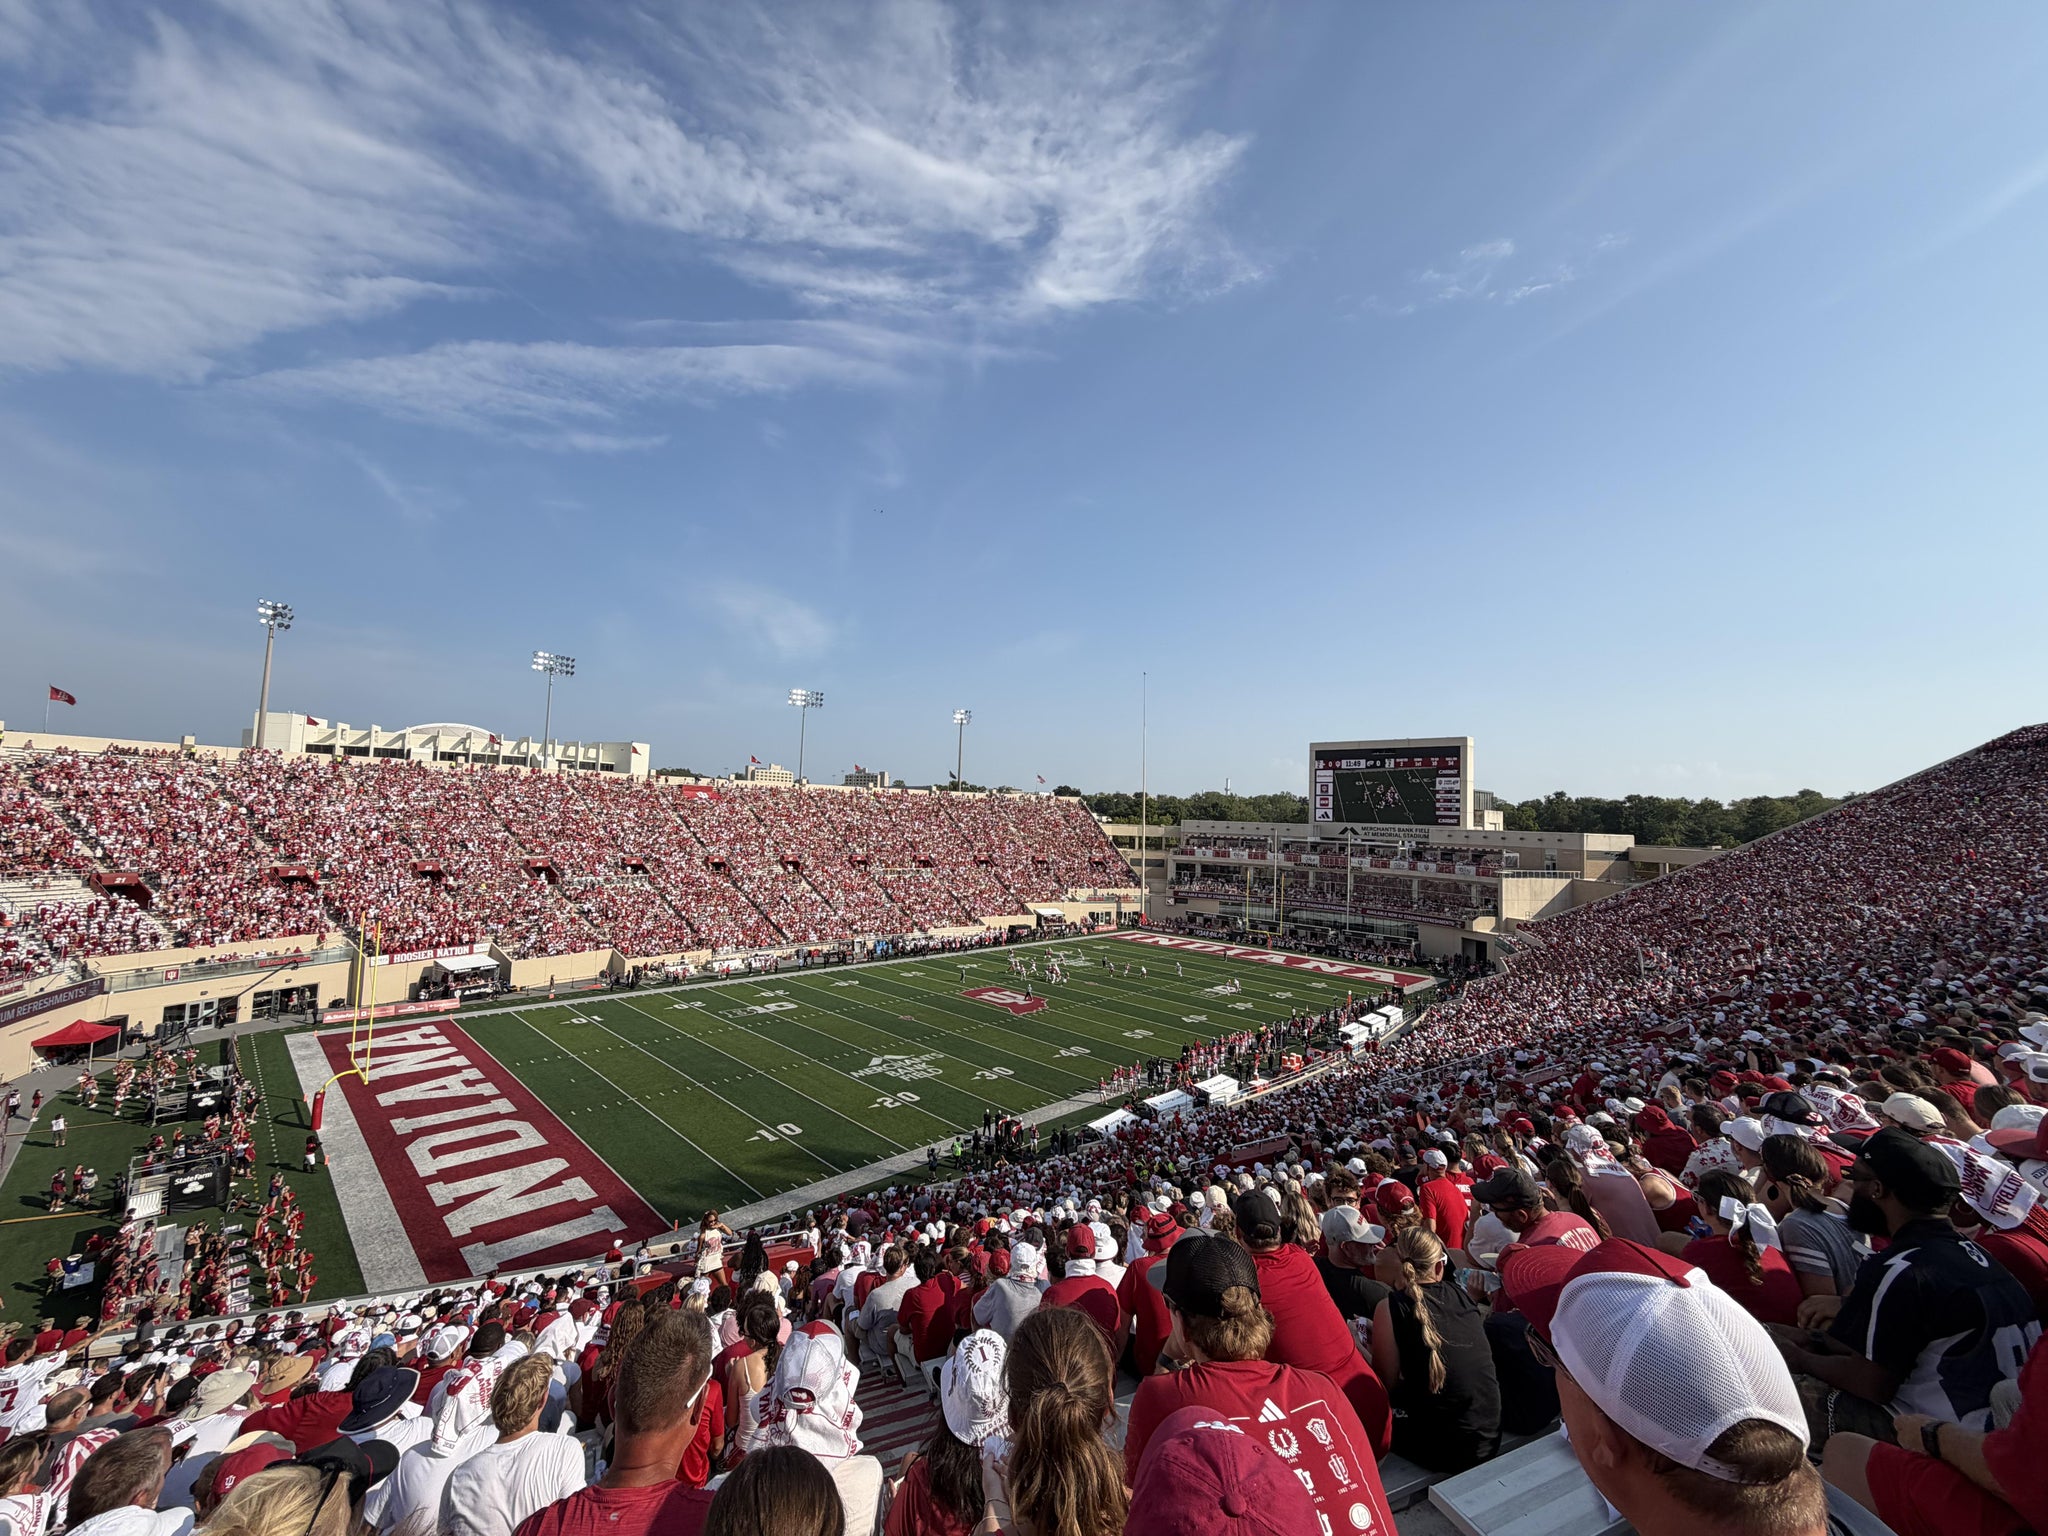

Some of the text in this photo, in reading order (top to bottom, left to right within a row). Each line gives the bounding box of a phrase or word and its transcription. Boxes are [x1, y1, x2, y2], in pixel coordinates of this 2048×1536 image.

[393, 950, 434, 964] HOOSIER
[437, 945, 470, 958] NATION
[1116, 933, 1400, 984] INDIANA
[16, 986, 87, 1017] REFRESHMENTS!
[1121, 1029, 1155, 1039] 50
[1059, 1046, 1091, 1058] 40
[850, 1052, 945, 1078] MERCHANTS
[884, 1061, 935, 1077] BANK
[975, 1066, 1015, 1081] 30
[899, 1067, 944, 1082] FIELD
[876, 1091, 921, 1108] 20
[756, 1123, 803, 1142] 10
[346, 1025, 628, 1277] INDIANA
